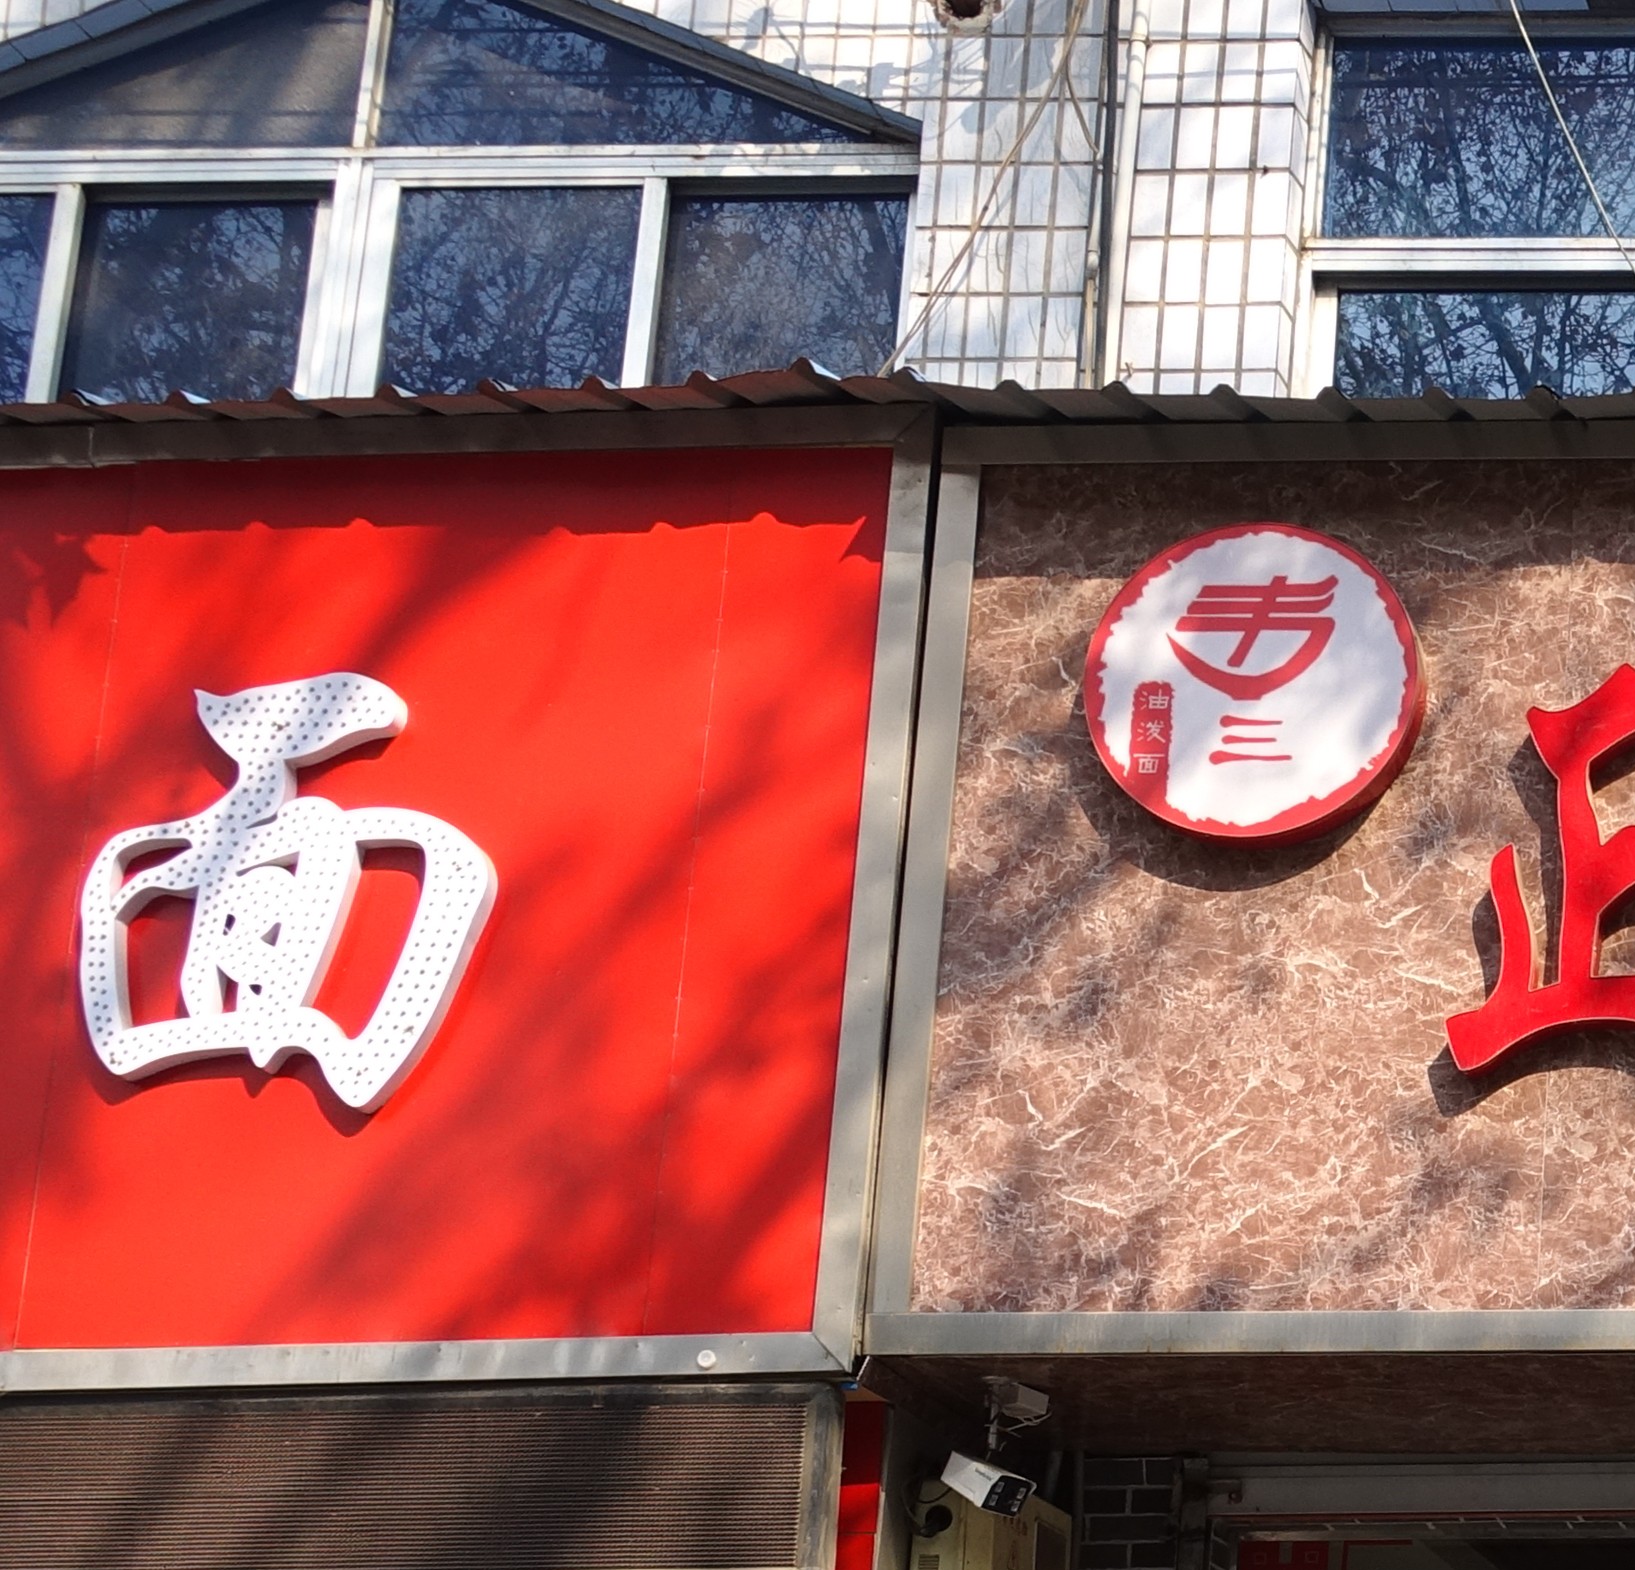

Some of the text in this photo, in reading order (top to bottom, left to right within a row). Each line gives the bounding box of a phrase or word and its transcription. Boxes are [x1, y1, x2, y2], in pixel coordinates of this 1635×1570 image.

[1132, 690, 1170, 775] 油泼面
[80, 672, 498, 1115] 面
